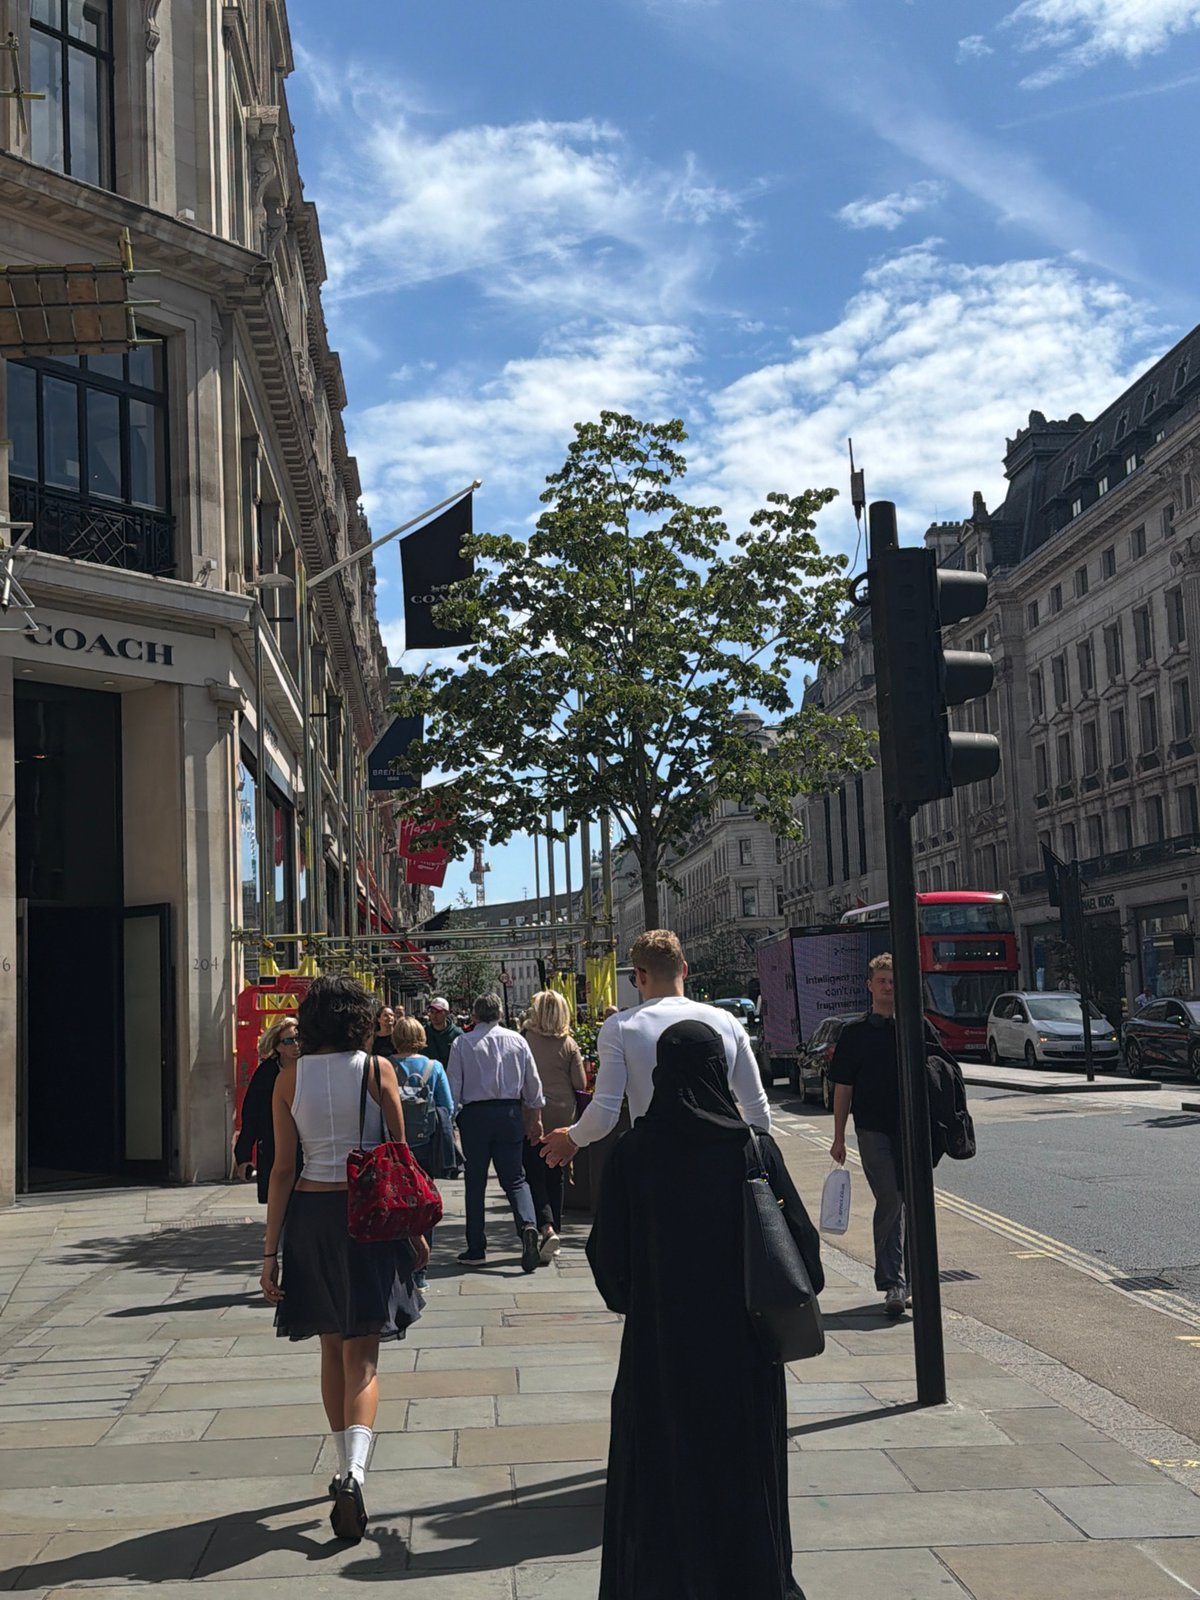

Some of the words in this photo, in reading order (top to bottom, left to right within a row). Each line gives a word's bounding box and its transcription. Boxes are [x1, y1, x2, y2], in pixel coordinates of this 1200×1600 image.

[24, 622, 174, 666] COACH
[193, 956, 220, 971] 204
[806, 974, 850, 985] Intelligent
[825, 987, 848, 997] can't
